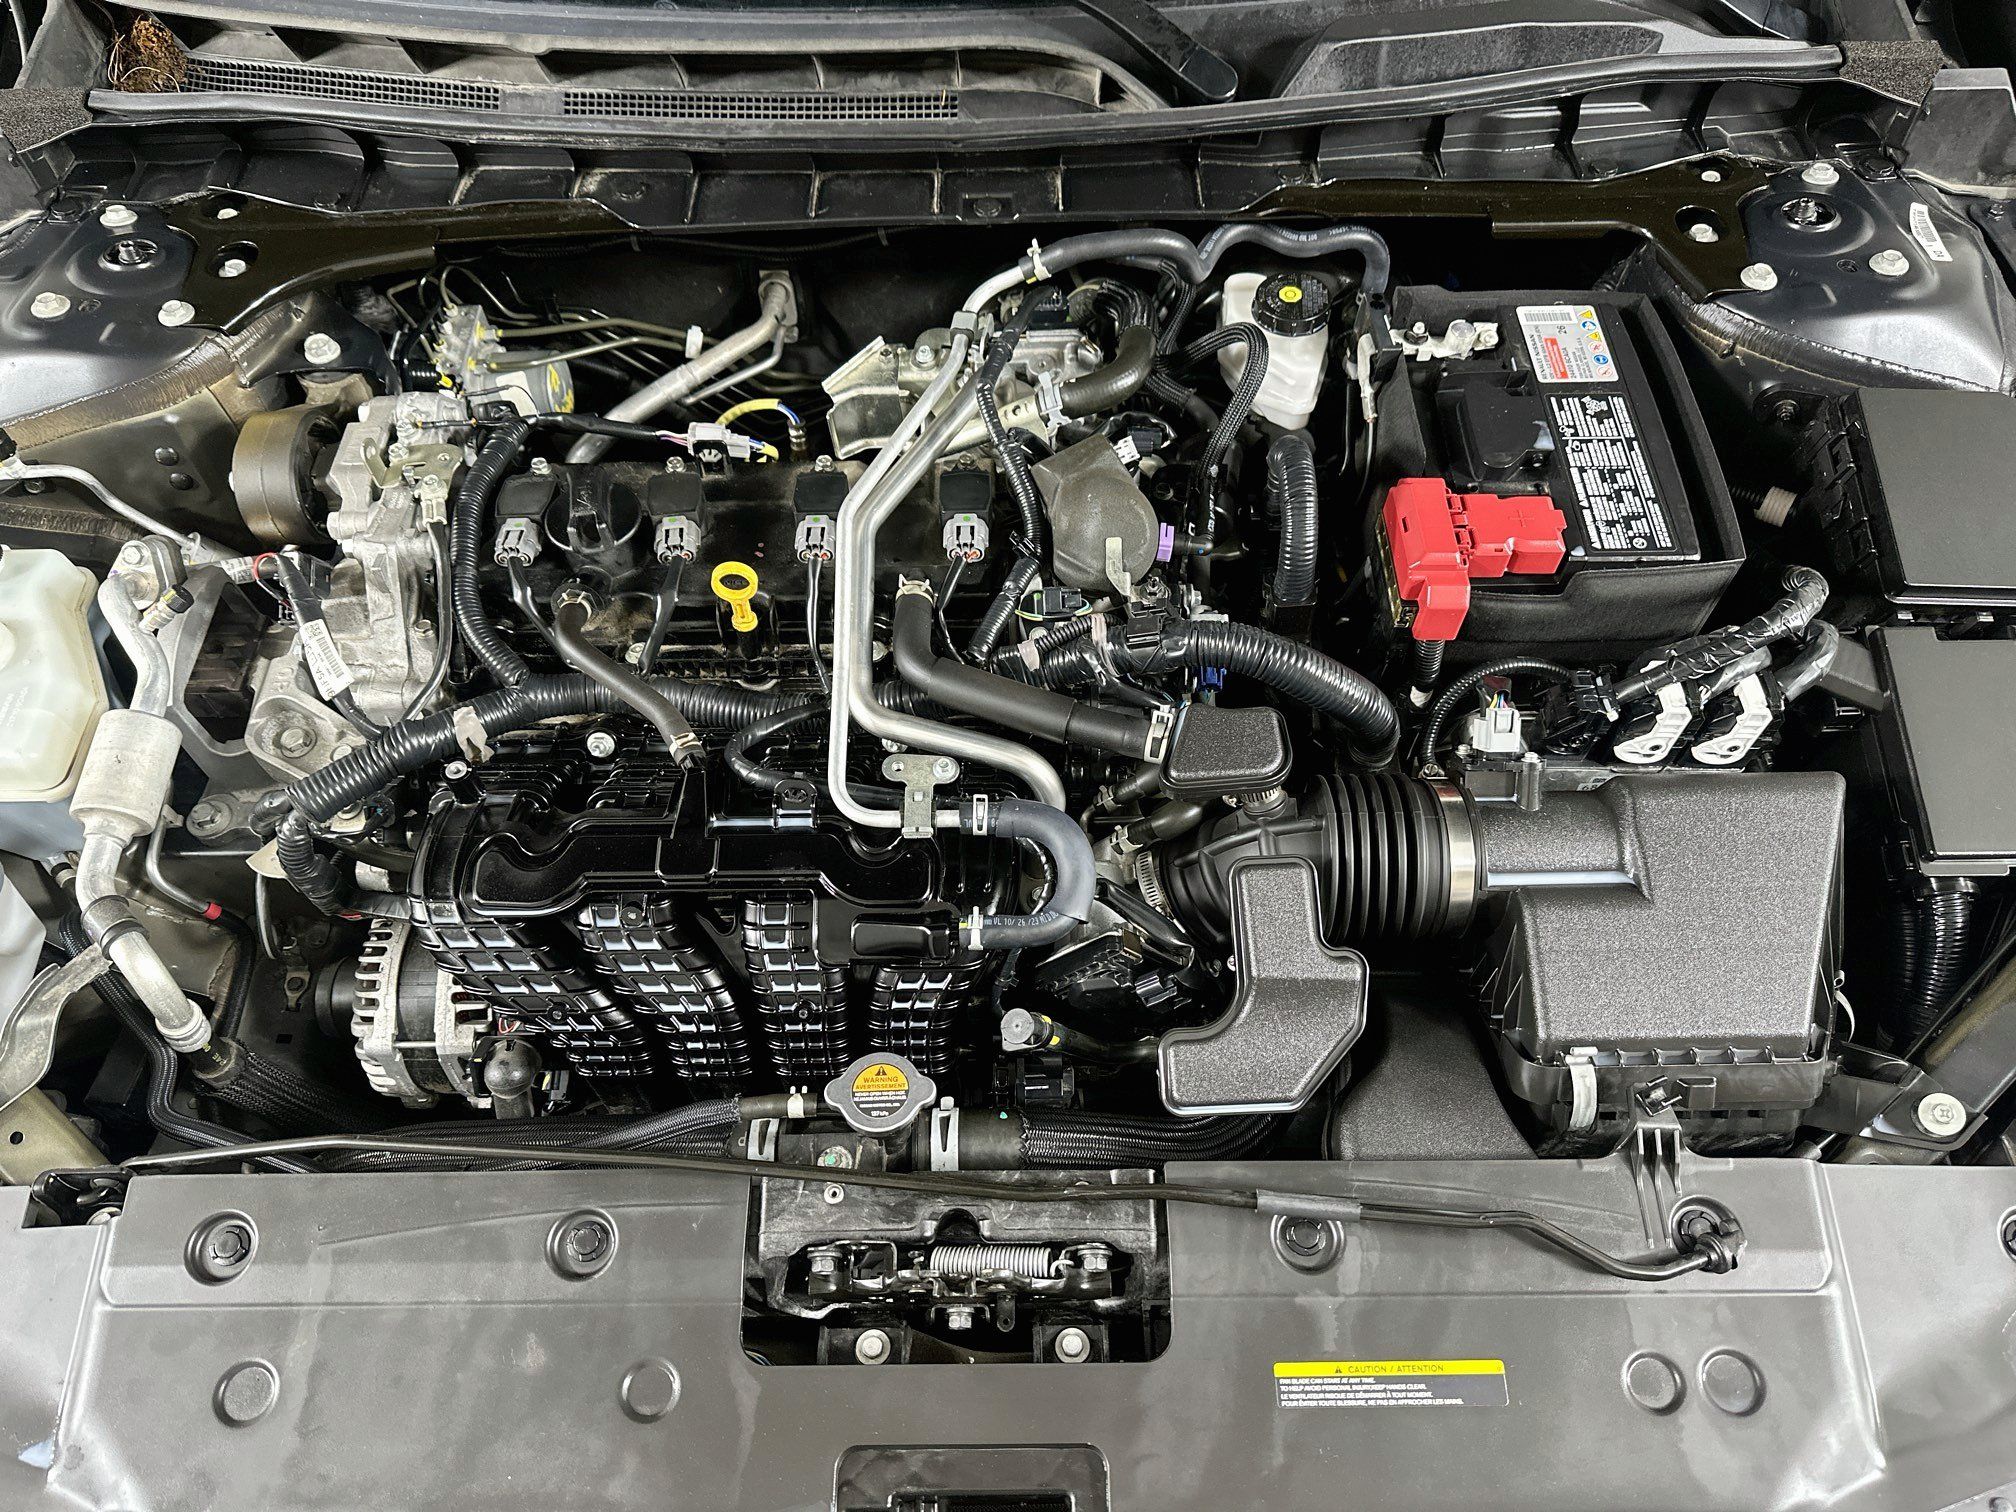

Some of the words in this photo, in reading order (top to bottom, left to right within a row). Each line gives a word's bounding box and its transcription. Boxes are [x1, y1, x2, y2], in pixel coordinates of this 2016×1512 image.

[1556, 325, 1567, 334] 26
[1528, 333, 1541, 356] NISSAN
[1397, 1365, 1443, 1373] ATTENTION
